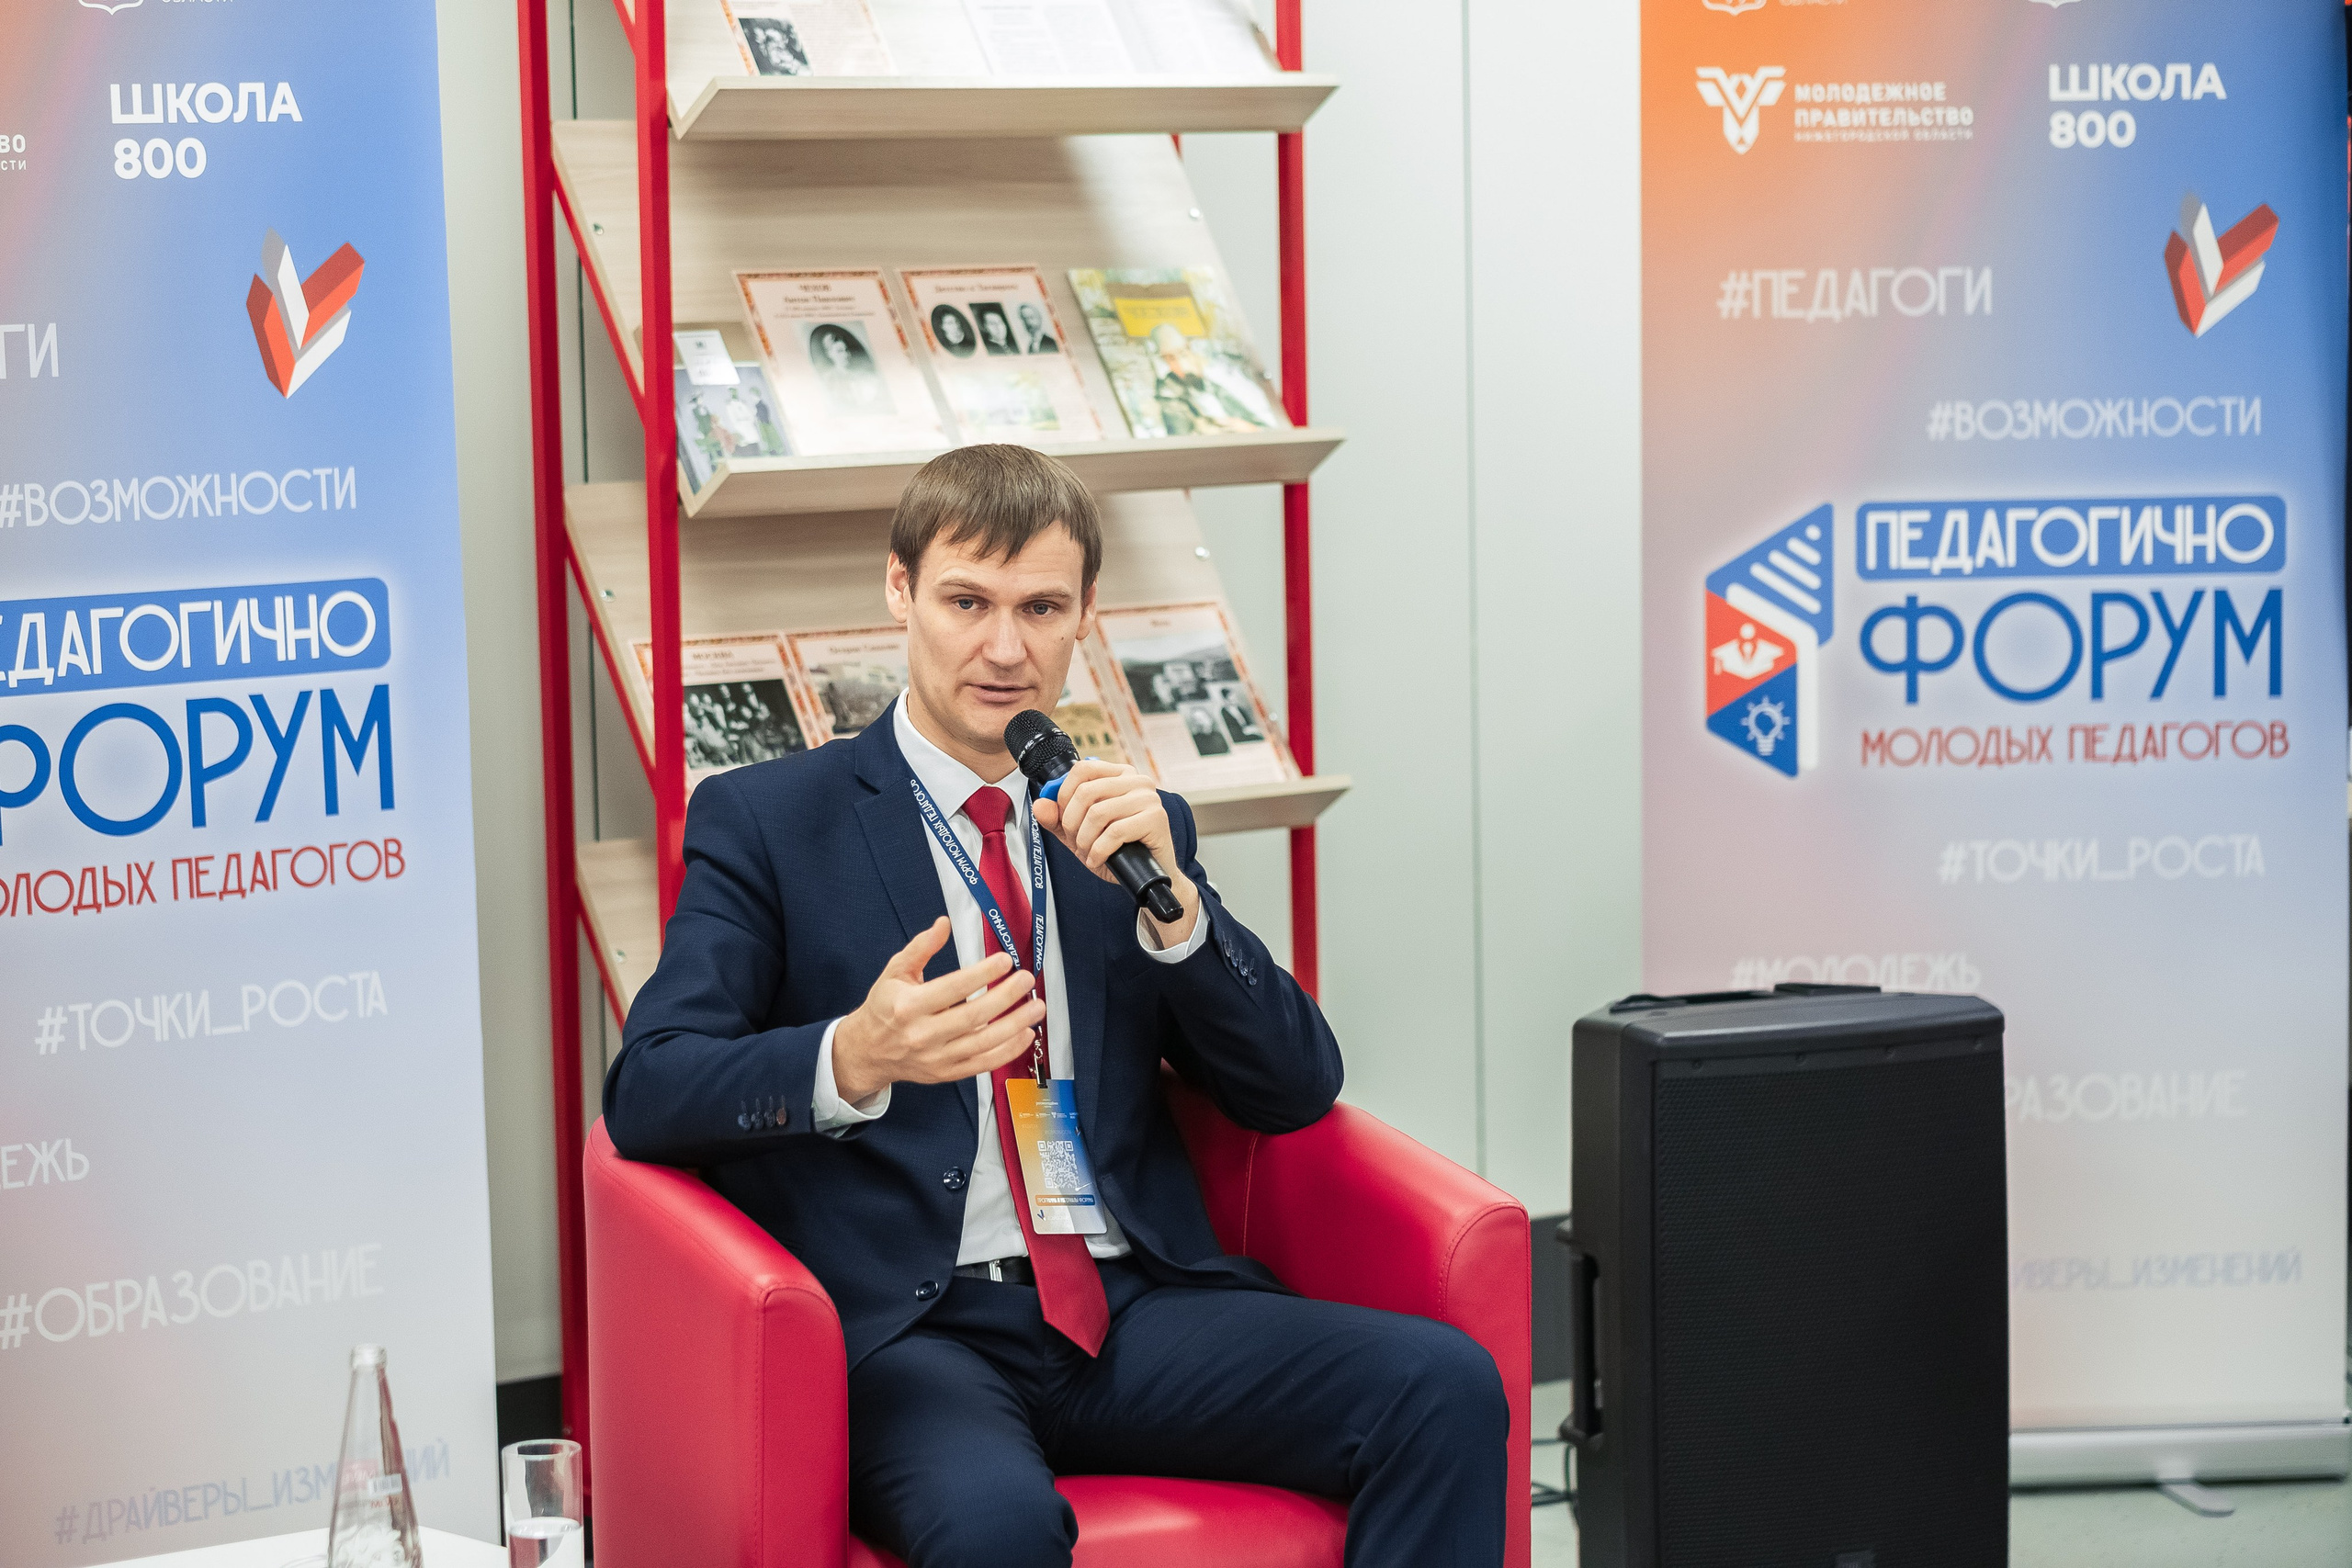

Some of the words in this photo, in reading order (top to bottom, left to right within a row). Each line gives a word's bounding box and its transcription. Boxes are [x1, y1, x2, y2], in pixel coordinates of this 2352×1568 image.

[110, 82, 302, 124] ШКОЛА
[1794, 82, 1947, 105] МОЛОДЕЖНОЕ
[2048, 62, 2227, 102] ШКОЛА
[1794, 106, 1974, 128] ПРАВИТЕЛЬСТВО
[2048, 109, 2136, 149] 800
[114, 137, 207, 179] 800
[1717, 267, 1993, 323] #ПЕДАГОГИ
[1928, 396, 2262, 442] #ВОЗМОЖНОСТИ
[0, 467, 357, 528] #ВОЗМОЖНОСТИ
[1865, 503, 2275, 575] ПЕДАГОГИЧНО
[0, 591, 377, 689] ДАГОГИЧНО
[1859, 587, 2284, 705] ФОРУМ
[1860, 726, 2054, 768] МОЛОДЫХ
[2067, 719, 2290, 765] ПЕДАГОГОВ
[933, 820, 963, 861] МОЛОДЫХ
[1938, 833, 2267, 885] #ТОЧКИ_РОСТА
[0, 861, 157, 918] ЛОДЫХ
[172, 838, 406, 902] ПЕДАГОГОВ
[956, 852, 978, 886] ФОРУМ
[1034, 846, 1044, 889] ПЕДАГОГОВ
[1035, 914, 1045, 971] ПЕДАГОГИЧНО
[35, 970, 388, 1055] #ТОЧКИ_РОСТА
[1, 1138, 90, 1190] ЕЖЬ
[0, 1243, 384, 1350] #ОБРАЗОВАНИЕ
[54, 1437, 450, 1545] #ДРАЙВЕРЫ_ИЗМИЙ
